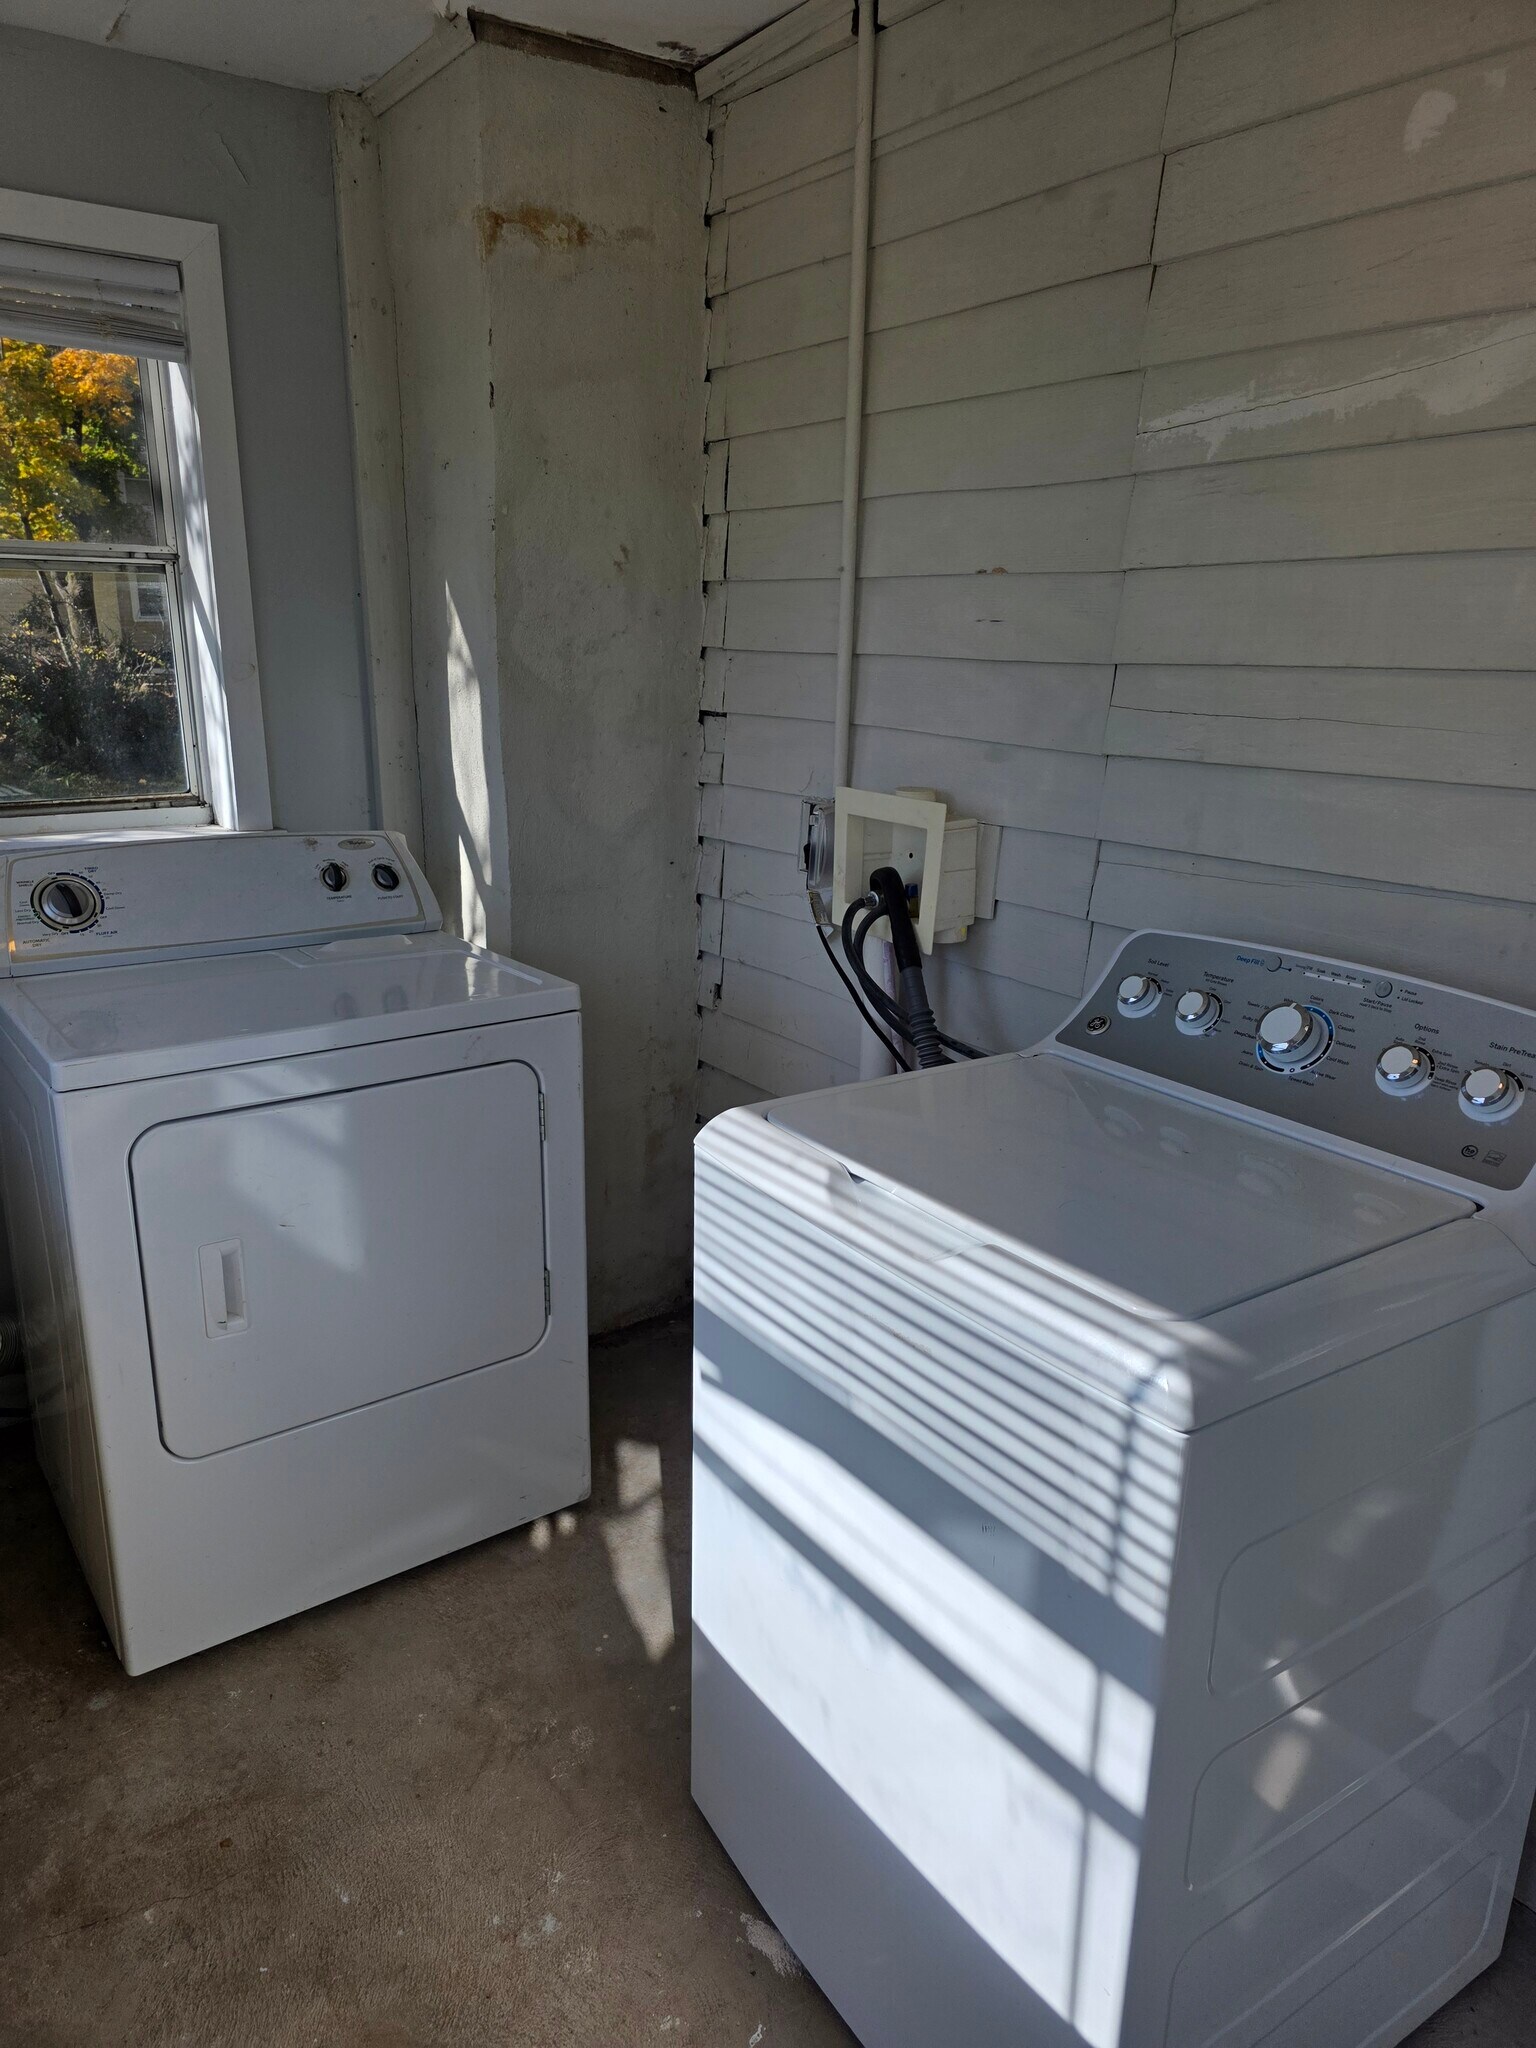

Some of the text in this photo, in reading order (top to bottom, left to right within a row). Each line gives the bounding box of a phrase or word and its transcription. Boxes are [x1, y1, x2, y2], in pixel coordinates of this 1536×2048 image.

[1236, 955, 1251, 964] Deep
[1203, 971, 1234, 983] Temperature
[1363, 997, 1392, 1008] Start/Pause
[1414, 1023, 1439, 1034] Options
[1489, 1041, 1536, 1059] Stain PreTrea
